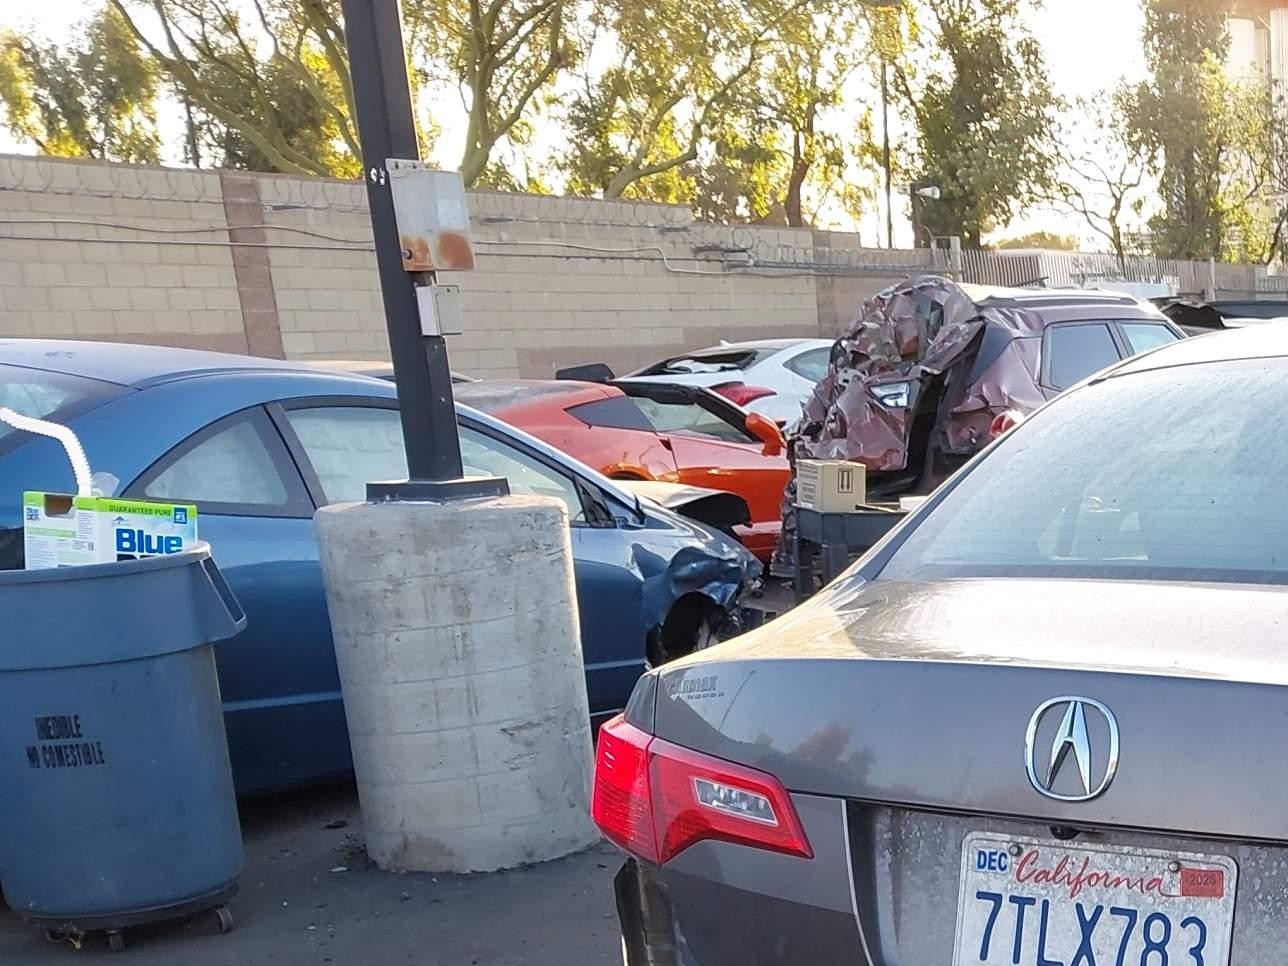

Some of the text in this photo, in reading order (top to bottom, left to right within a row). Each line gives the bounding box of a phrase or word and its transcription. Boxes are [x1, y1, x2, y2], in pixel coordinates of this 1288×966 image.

[109, 505, 153, 515] GUARANTEED
[154, 508, 172, 517] PURE
[115, 528, 183, 554] Blue
[35, 715, 83, 740] INEDIBLE
[26, 742, 105, 768] NO COMESTIBLE
[976, 850, 1008, 872] DEC
[1015, 850, 1180, 899] California
